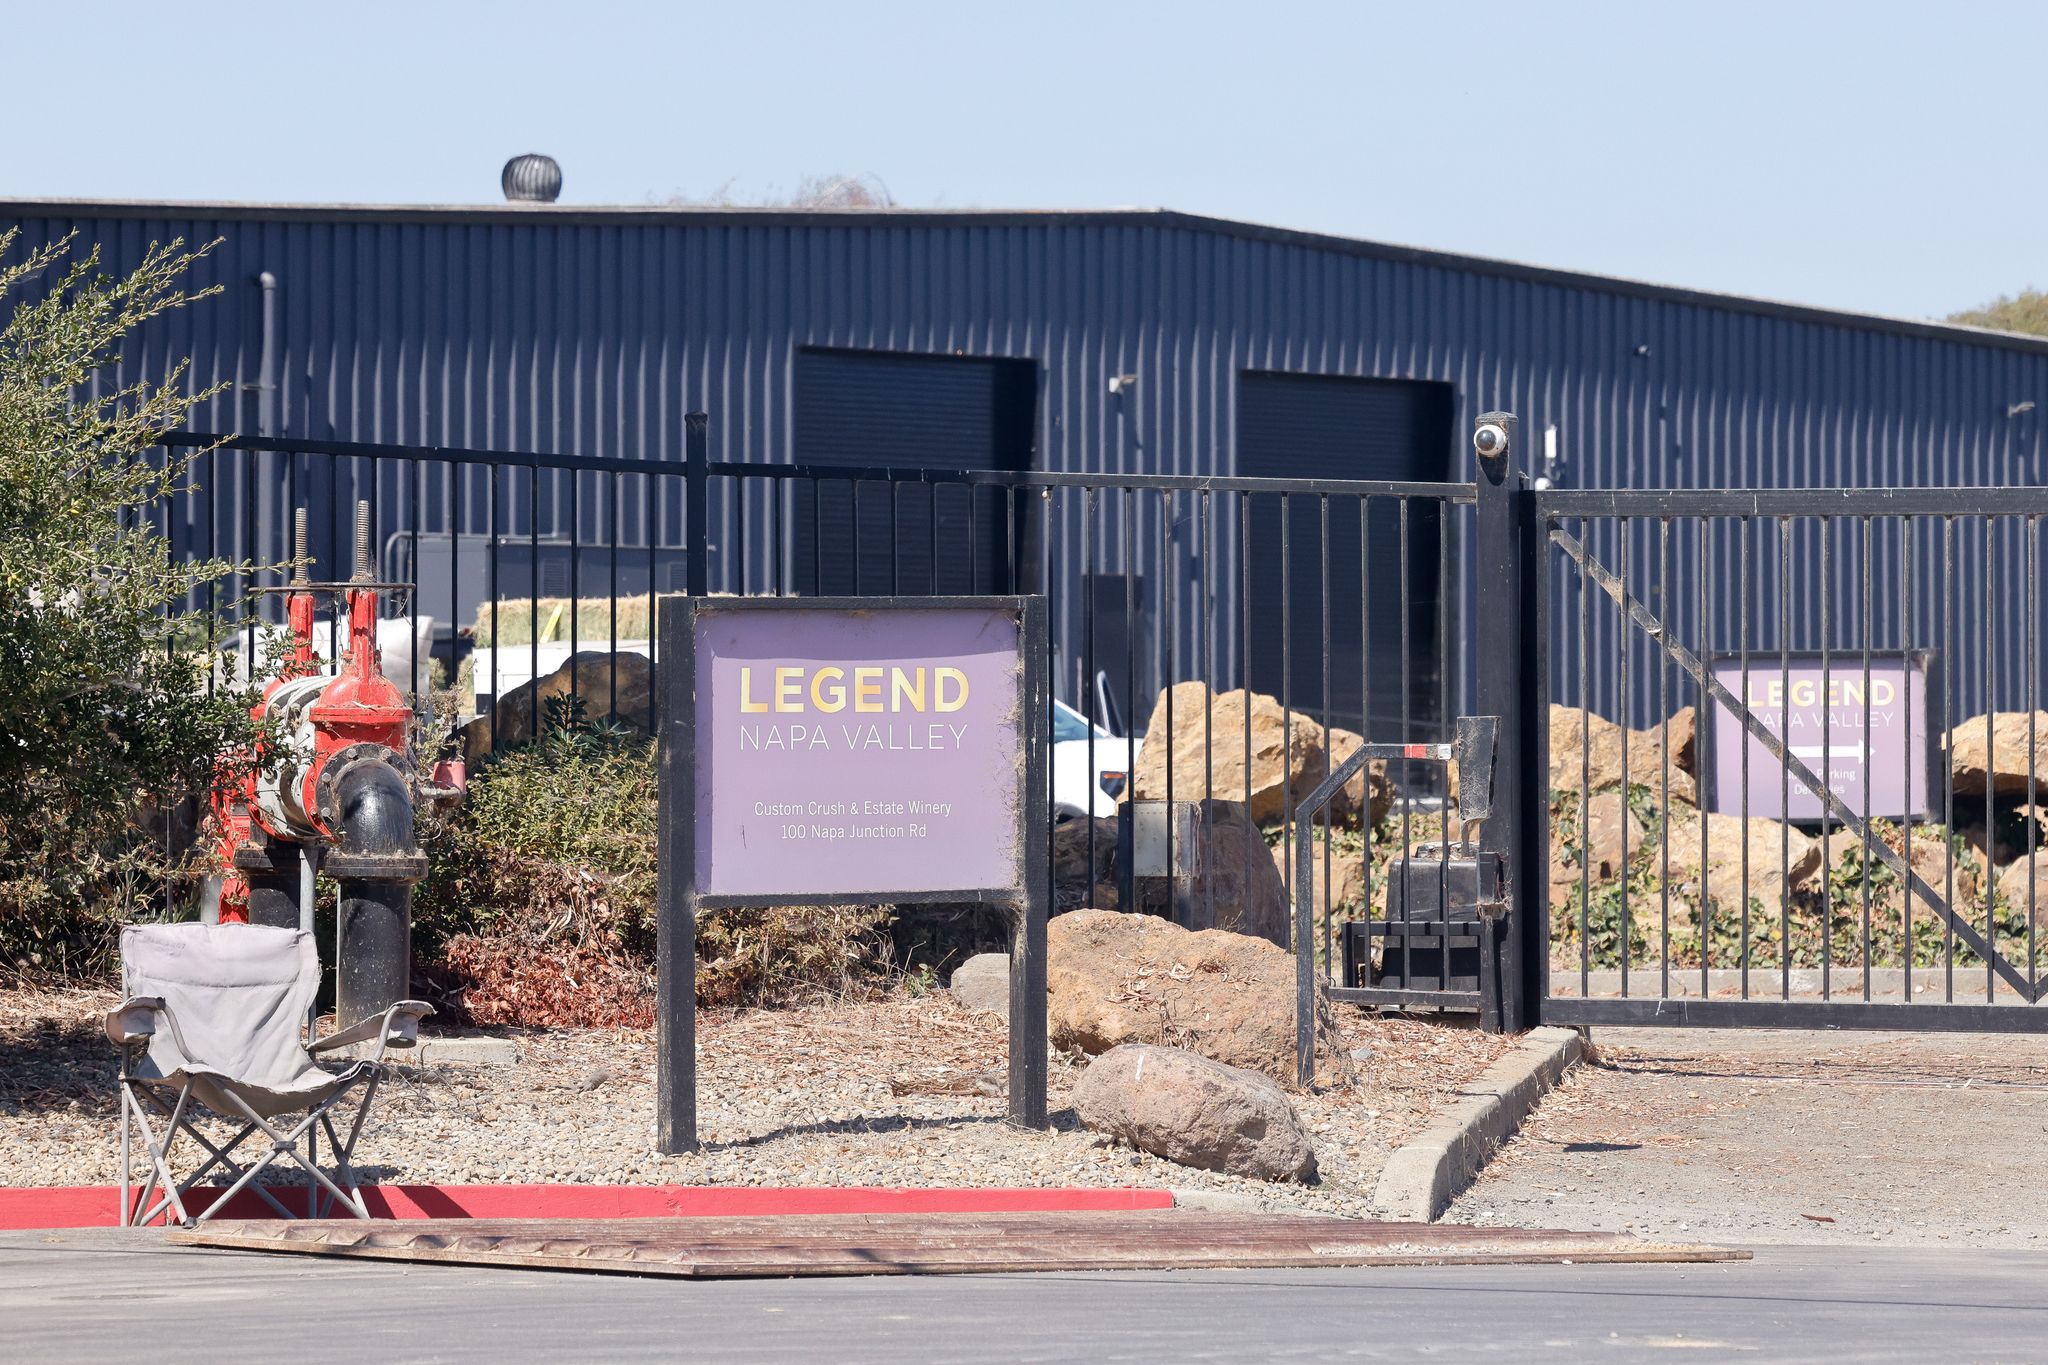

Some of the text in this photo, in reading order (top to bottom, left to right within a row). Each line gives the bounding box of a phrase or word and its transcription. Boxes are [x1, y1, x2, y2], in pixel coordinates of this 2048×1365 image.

[740, 667, 970, 713] LEGEND
[1746, 679, 1895, 707] LEGEND
[740, 724, 969, 750] NAPA VALLEY
[1816, 768, 1856, 782] Prking
[754, 800, 952, 817] Custom Crush & Estate Winery
[781, 823, 927, 841] 100 Napa Junction Rd
